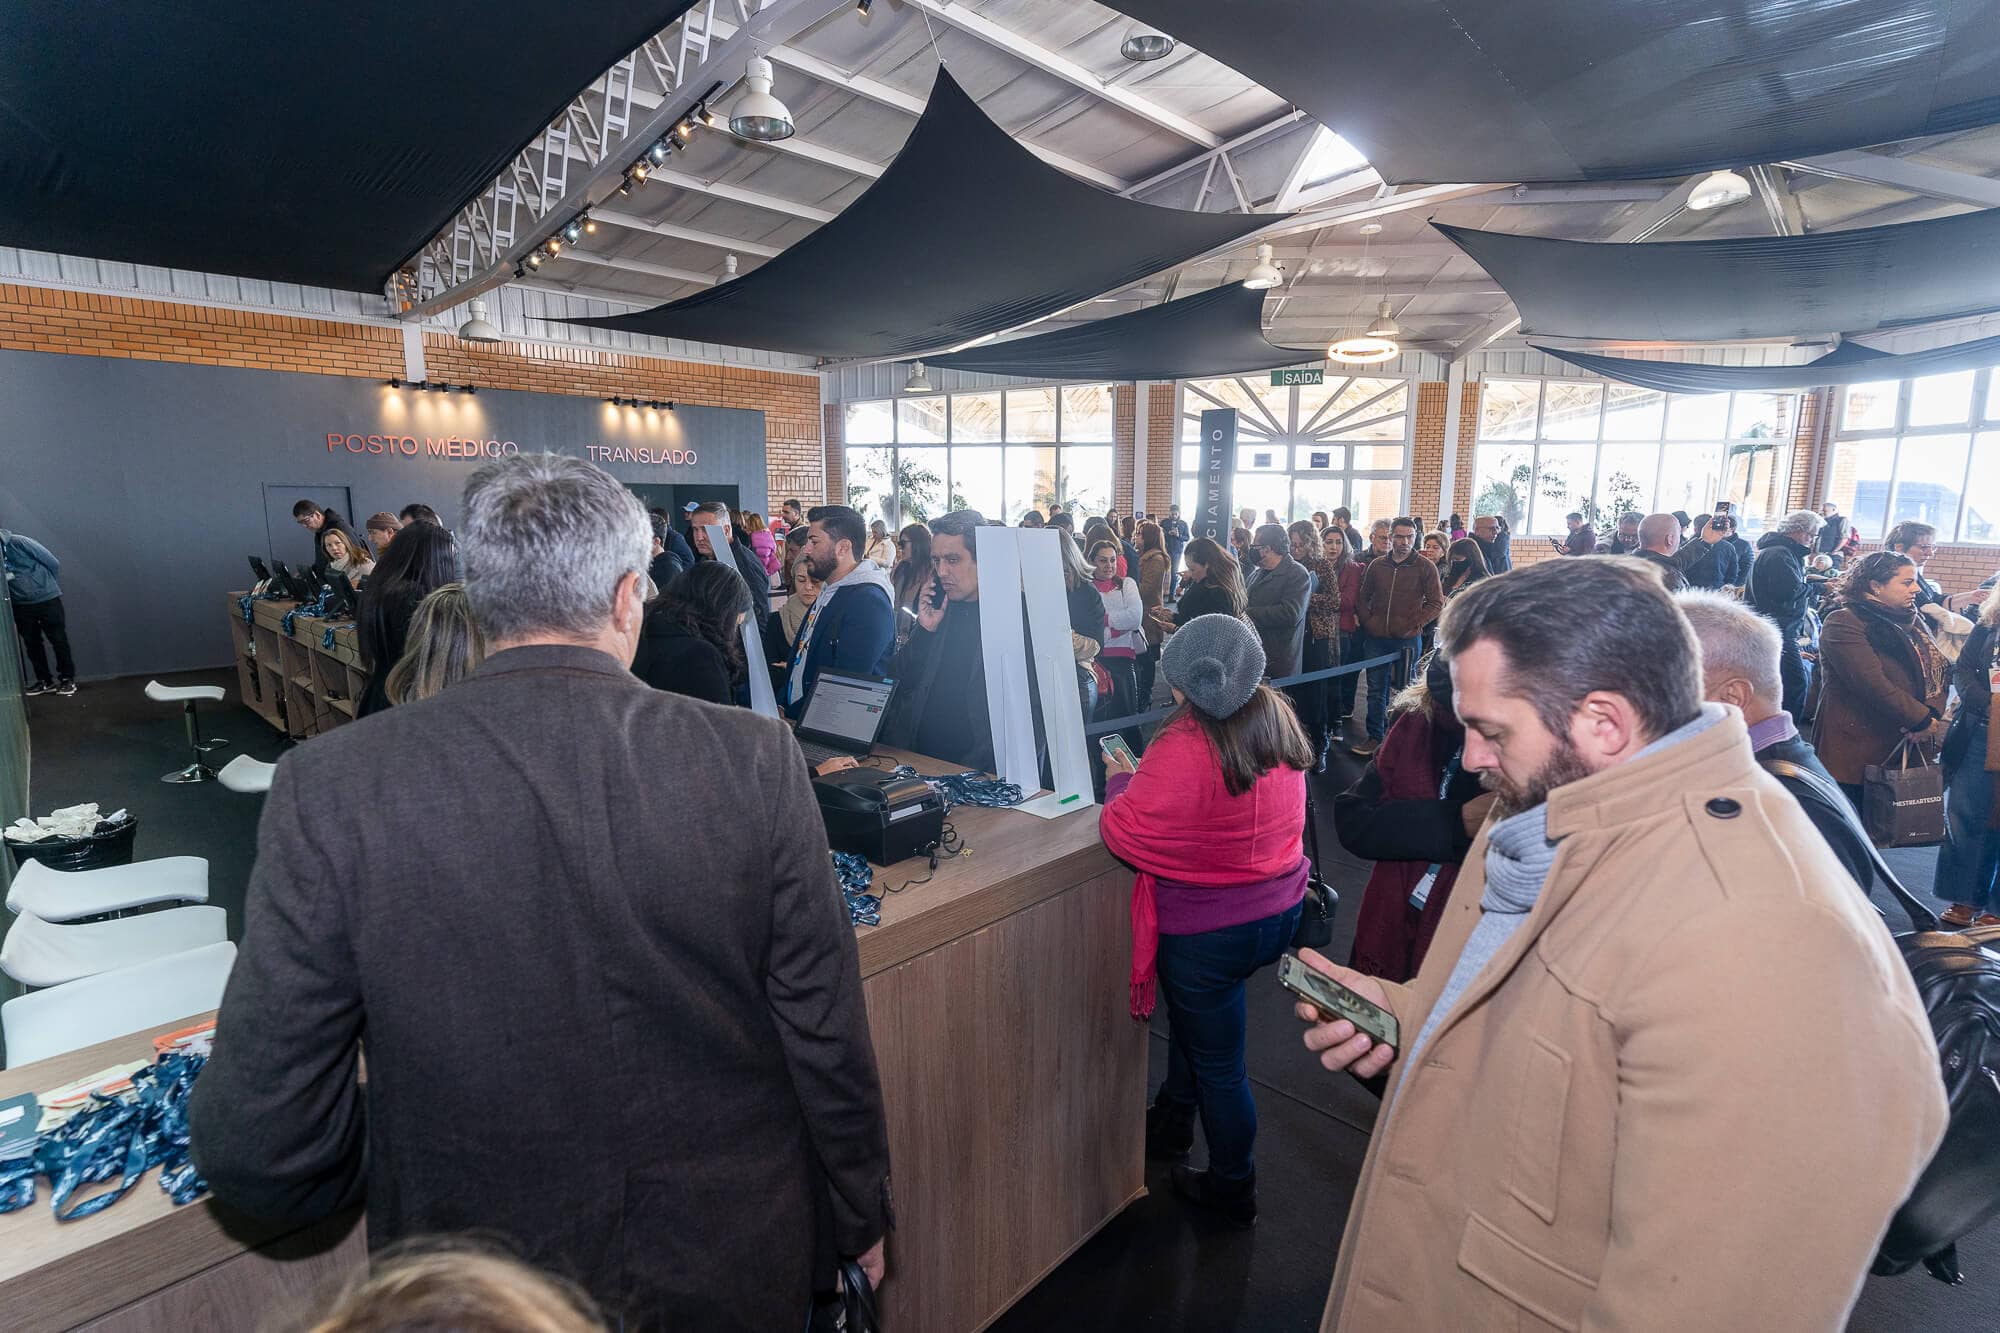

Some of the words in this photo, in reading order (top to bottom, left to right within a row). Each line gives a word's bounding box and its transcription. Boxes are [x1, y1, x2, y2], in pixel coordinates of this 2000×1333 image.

[1285, 370, 1321, 384] SAÍDA
[327, 433, 418, 456] POSTO
[427, 435, 518, 457] MÉDICO
[586, 445, 697, 465] TRANSLADO
[1207, 429, 1223, 539] CIAMENTO
